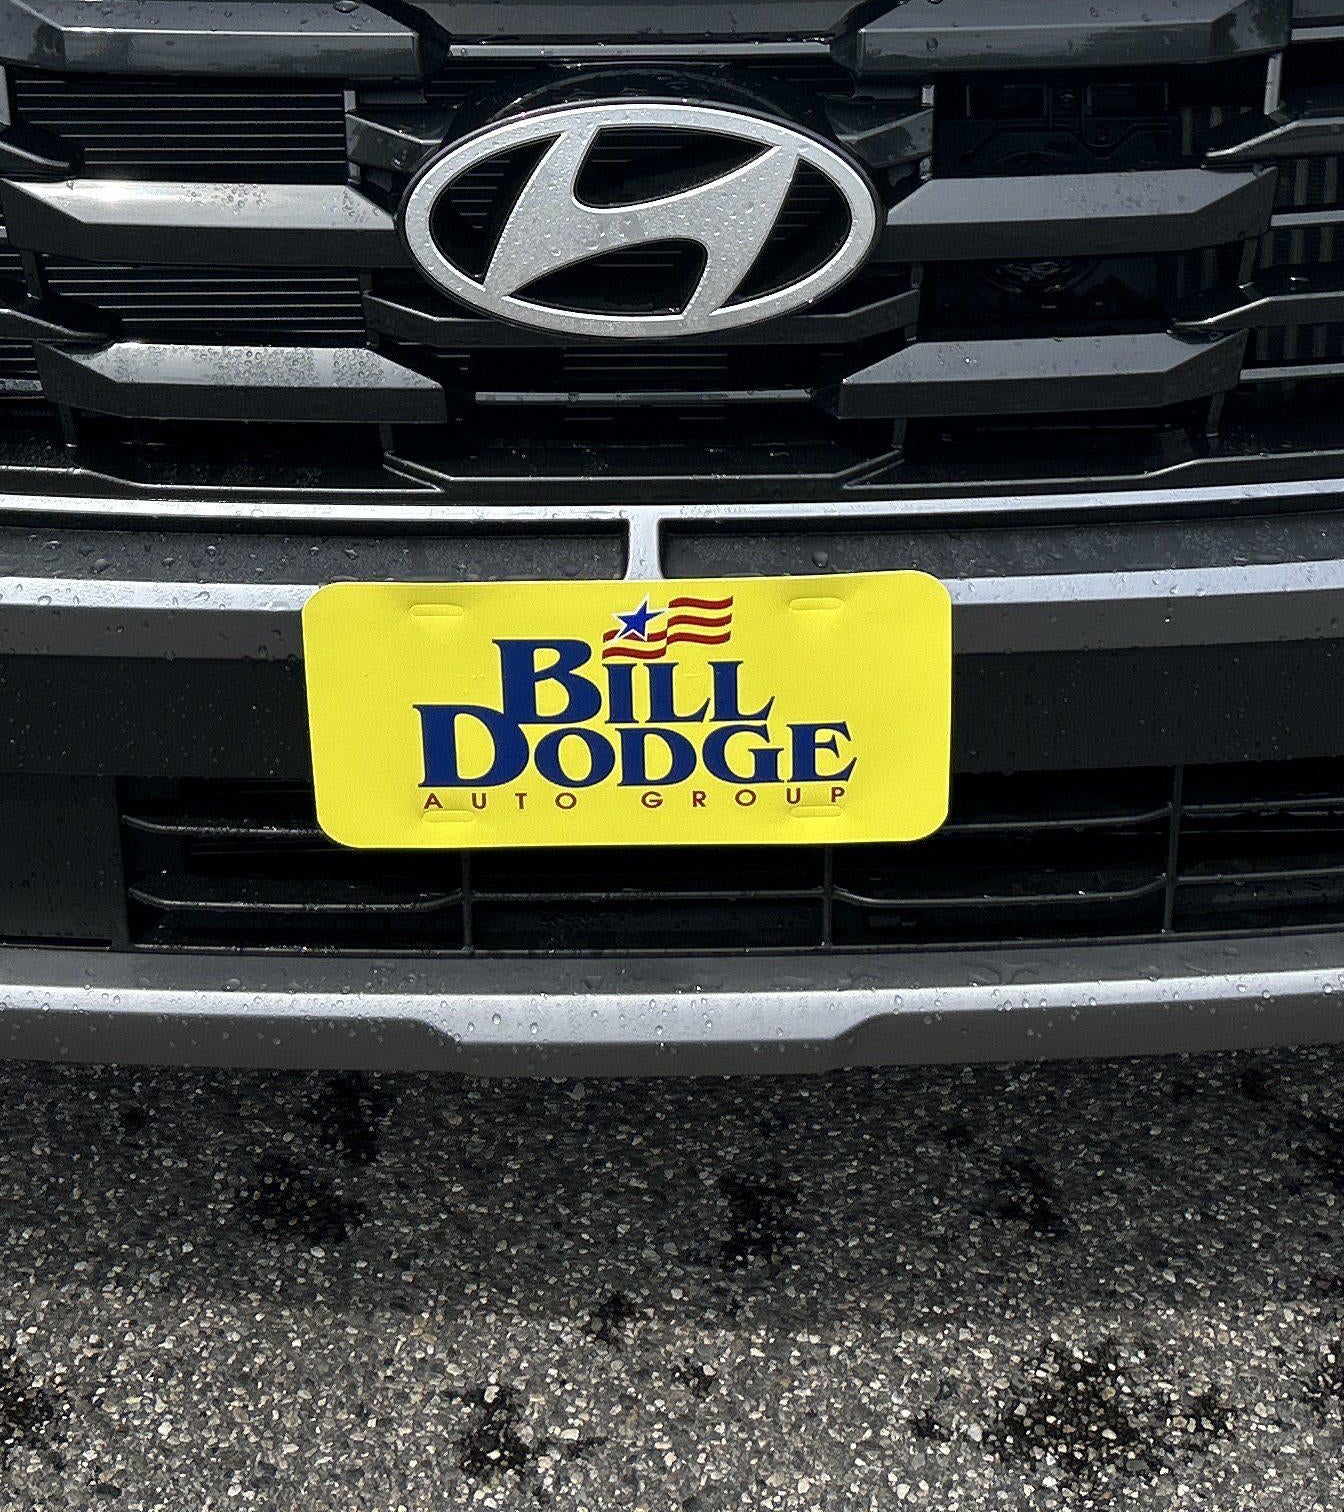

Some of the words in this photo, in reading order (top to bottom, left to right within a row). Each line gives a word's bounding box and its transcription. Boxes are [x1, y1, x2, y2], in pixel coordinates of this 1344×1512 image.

[492, 638, 775, 725] BILL
[413, 702, 857, 788] DODGE
[424, 790, 578, 810] AUTO
[641, 786, 846, 809] GROUP
